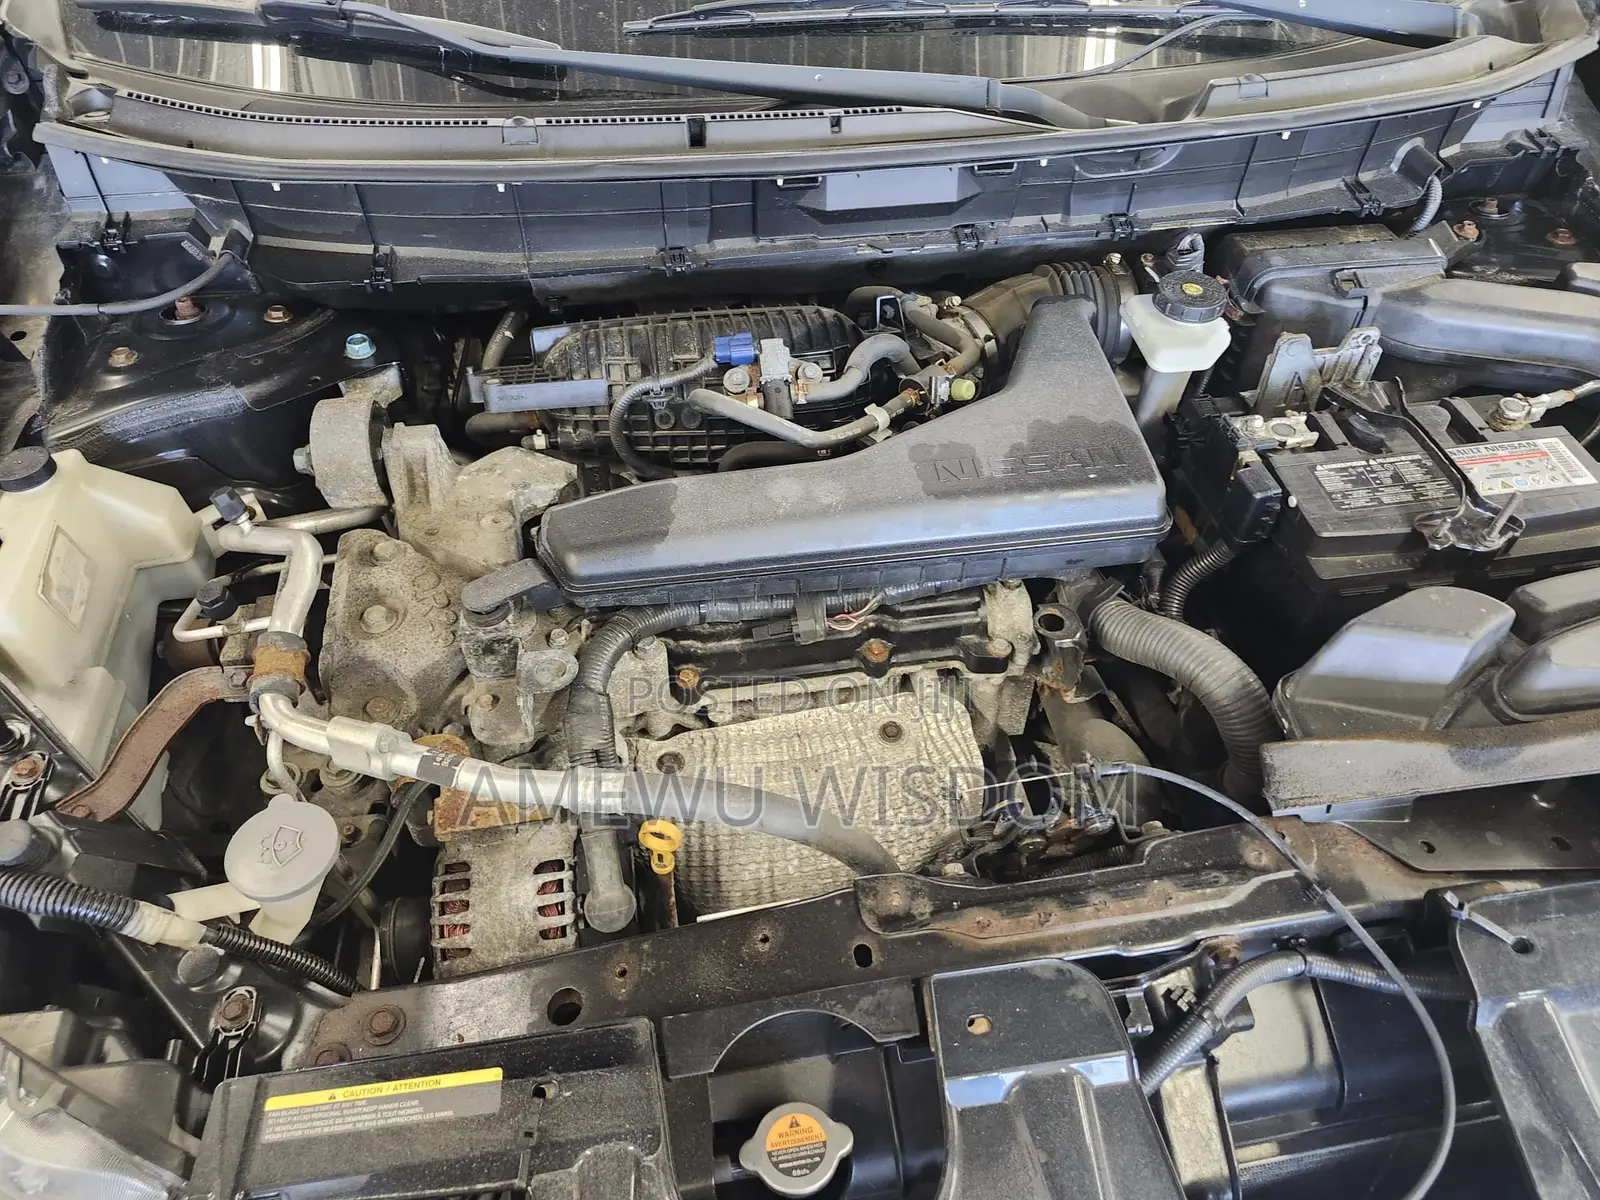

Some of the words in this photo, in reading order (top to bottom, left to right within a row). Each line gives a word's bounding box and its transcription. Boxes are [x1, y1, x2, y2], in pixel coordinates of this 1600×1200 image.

[1448, 446, 1482, 458] NAULT
[1484, 440, 1540, 454] NISSAN
[932, 447, 1127, 482] NISSAN
[343, 1086, 382, 1097] CAUTION
[392, 1079, 441, 1091] ATTENTION
[771, 1133, 823, 1147] AVERTISSEMENT
[778, 1126, 813, 1138] WARNING
